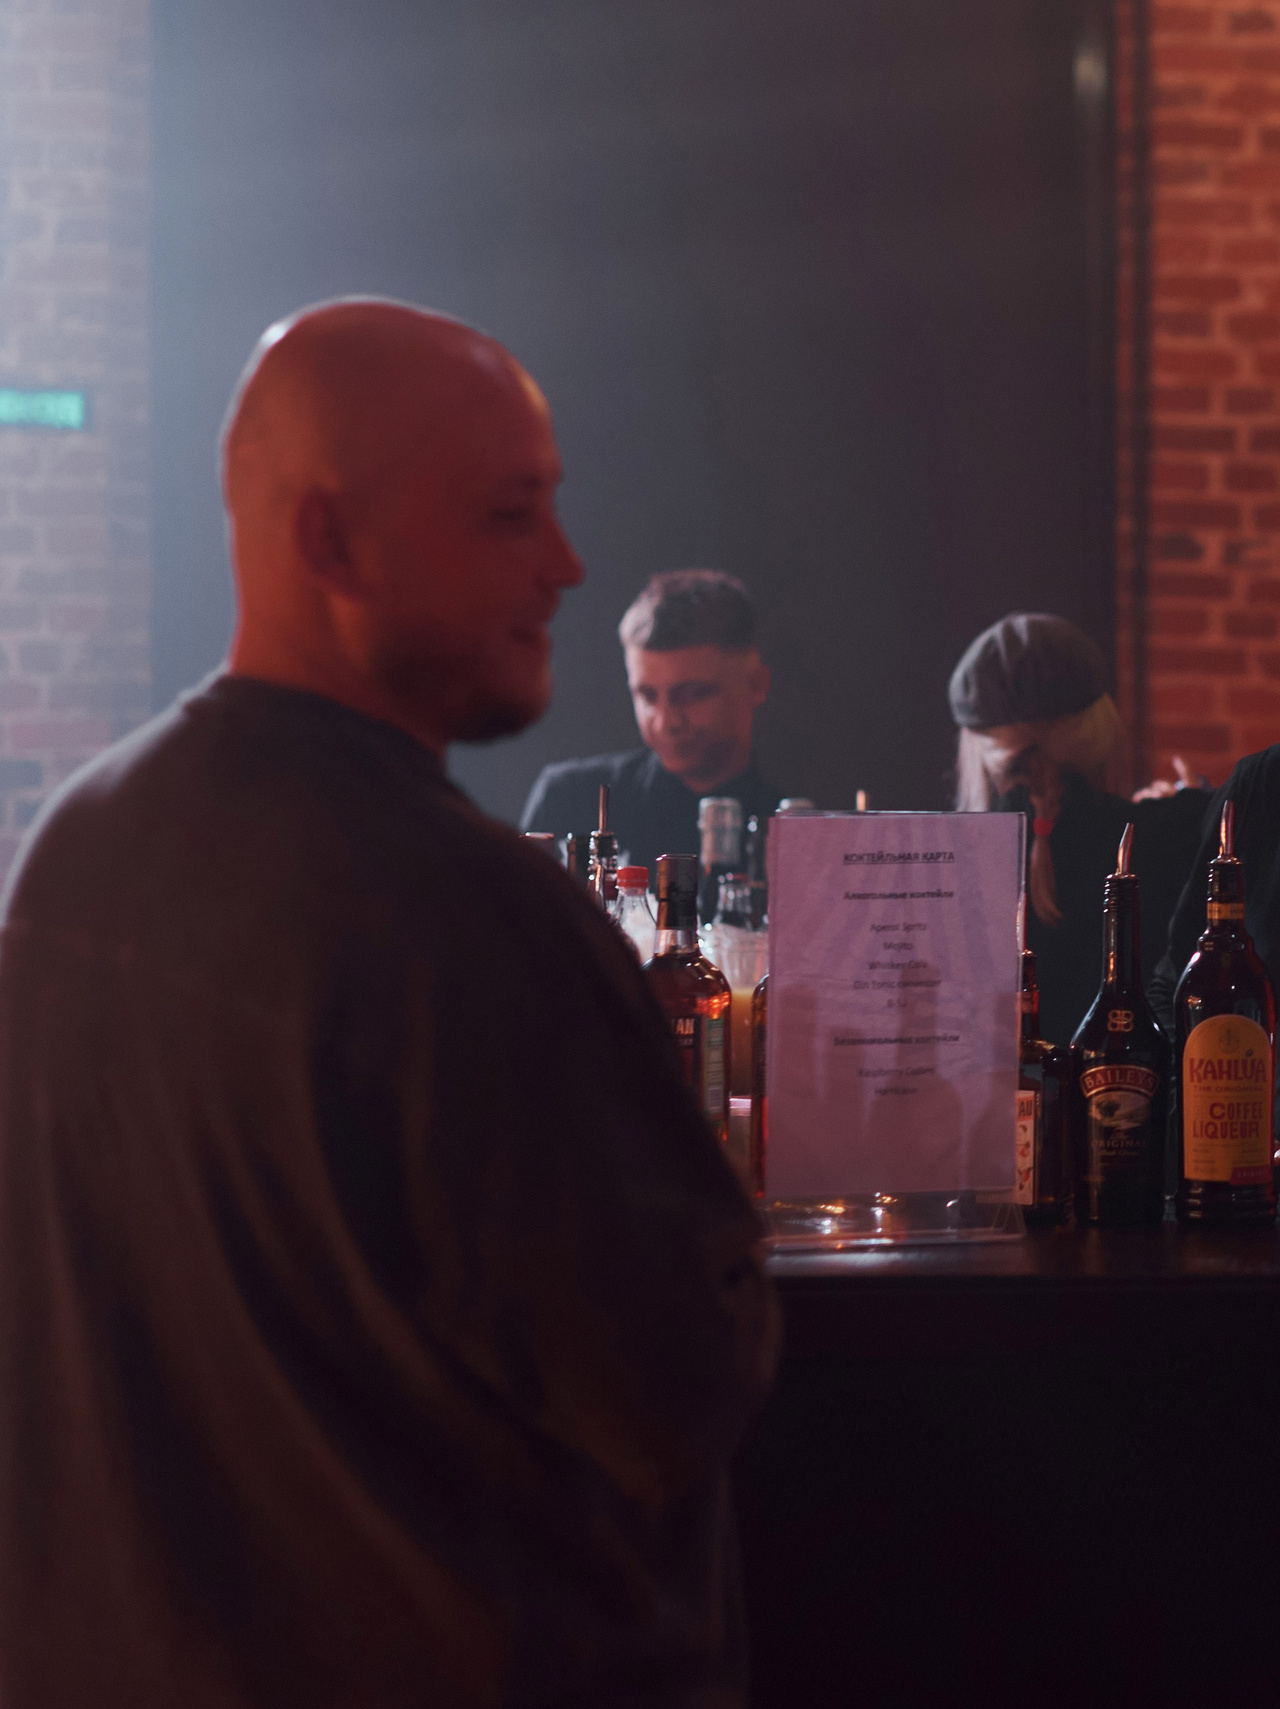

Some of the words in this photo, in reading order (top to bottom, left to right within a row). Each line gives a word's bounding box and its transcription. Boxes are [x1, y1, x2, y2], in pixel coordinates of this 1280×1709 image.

[843, 851, 919, 864] КОКТЕЙЛЬНАЯ
[922, 852, 955, 863] КАРТА
[1084, 1070, 1155, 1089] BAILEYS
[1209, 1101, 1263, 1120] COFFEE
[1192, 1120, 1260, 1140] LIQUEUR
